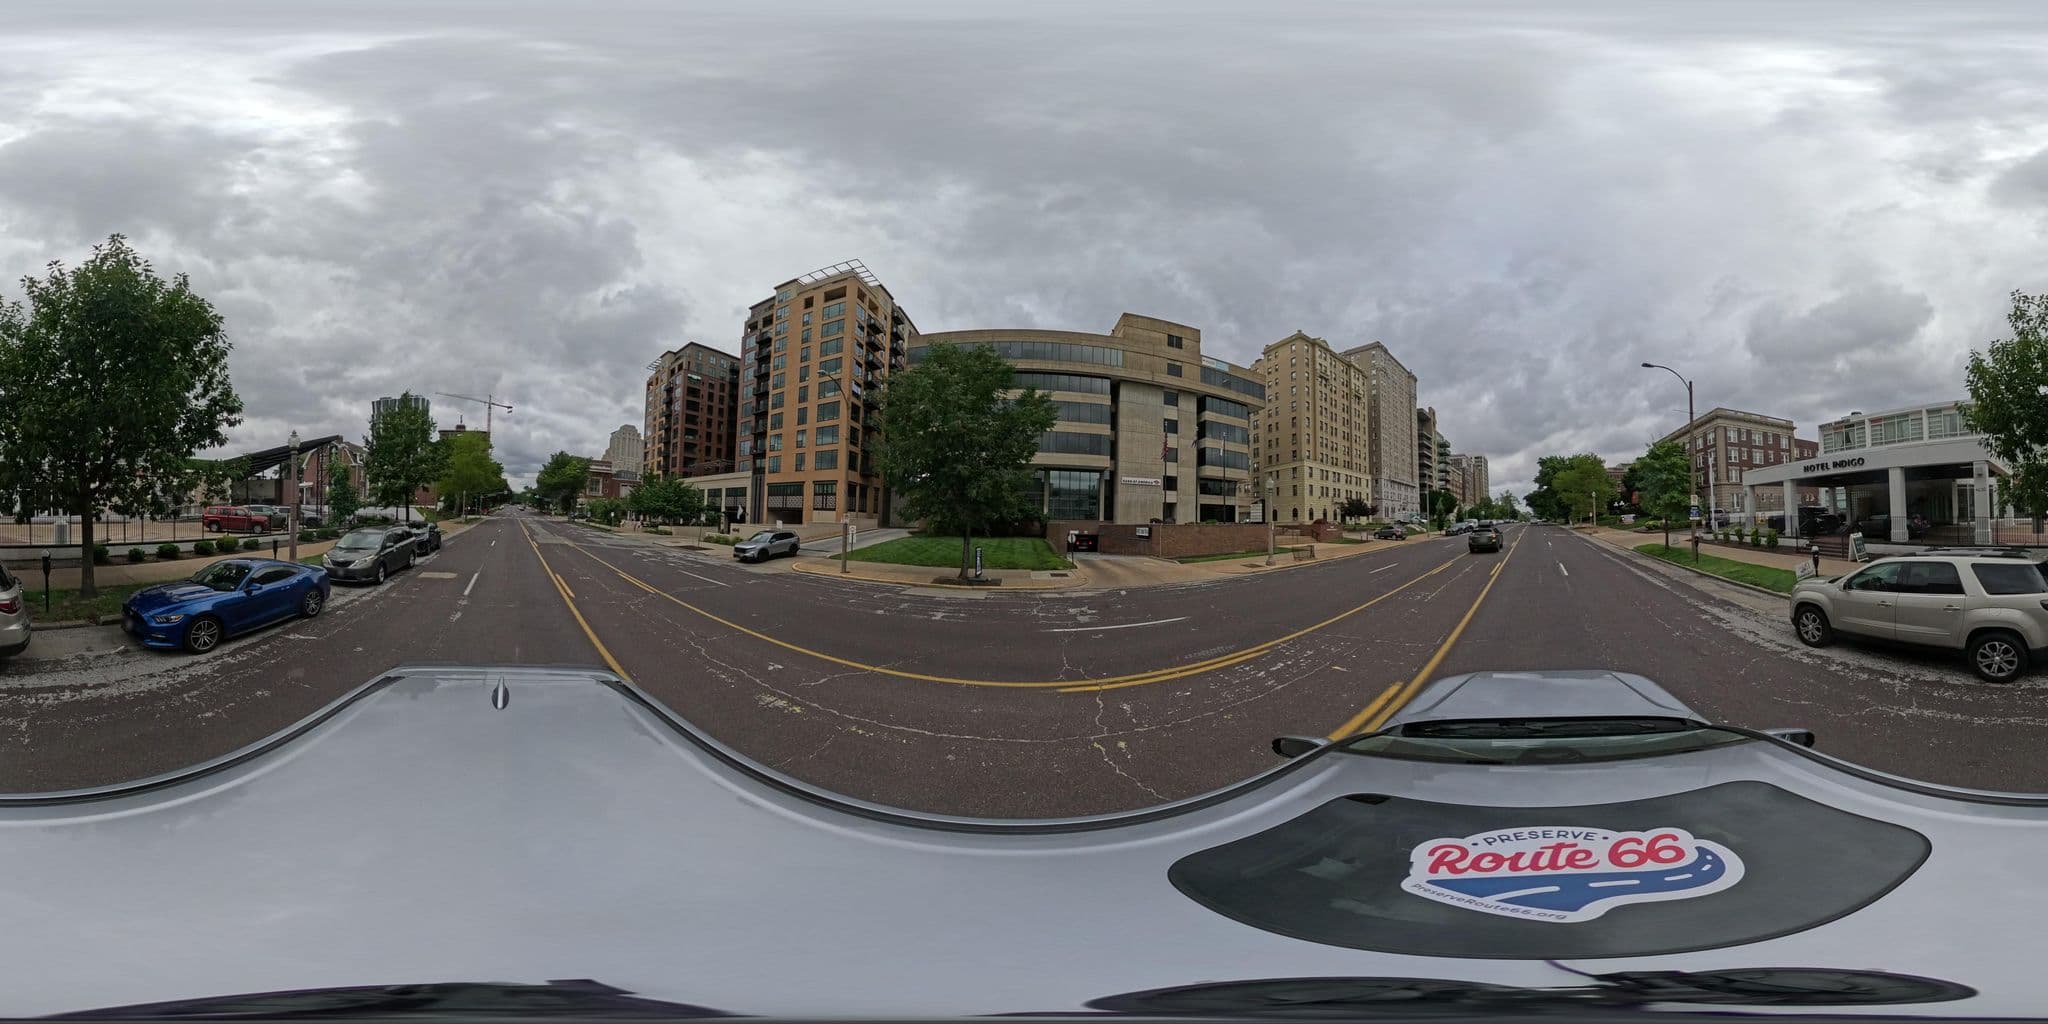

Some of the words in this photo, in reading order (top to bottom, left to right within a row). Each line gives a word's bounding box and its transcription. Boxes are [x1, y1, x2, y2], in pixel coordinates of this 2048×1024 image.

[1803, 462, 1831, 473] HOTEL
[1832, 457, 1865, 469] INDIGO
[1483, 830, 1598, 846] PRESERVE
[1427, 842, 1600, 874] Route
[1608, 833, 1686, 868] 66
[1411, 882, 1568, 920] PreserveRoute66.org
